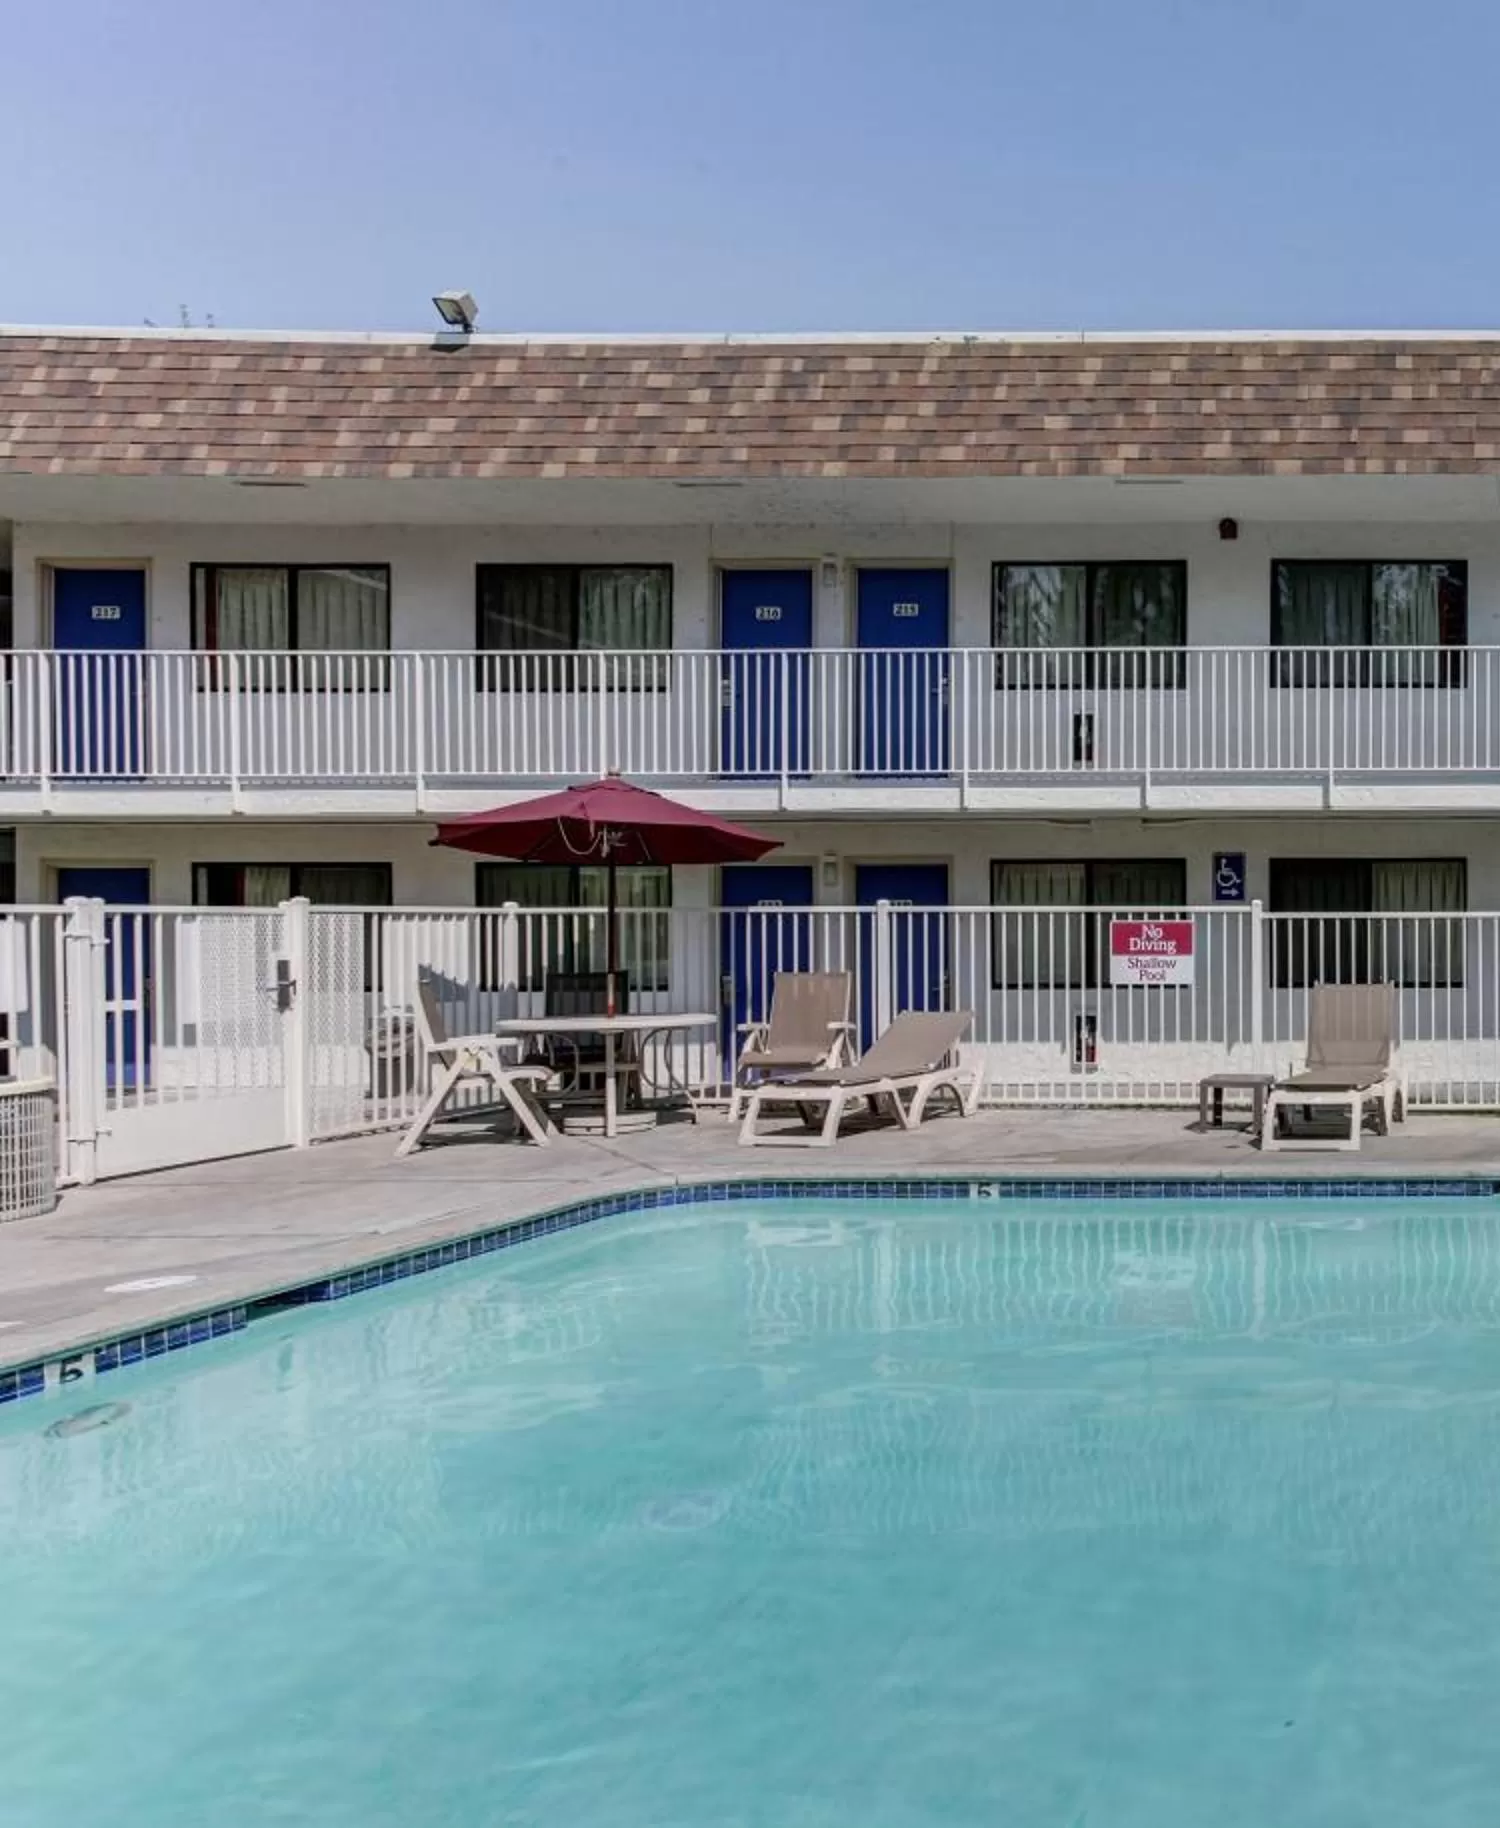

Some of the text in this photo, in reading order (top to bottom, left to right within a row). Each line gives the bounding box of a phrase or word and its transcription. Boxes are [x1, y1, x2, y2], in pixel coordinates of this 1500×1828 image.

[1142, 924, 1163, 939] No
[1129, 938, 1177, 955] Diving
[1128, 957, 1177, 969] Shallow
[1139, 970, 1166, 981] Pool
[978, 1181, 992, 1199] 5
[59, 1354, 83, 1384] 5
